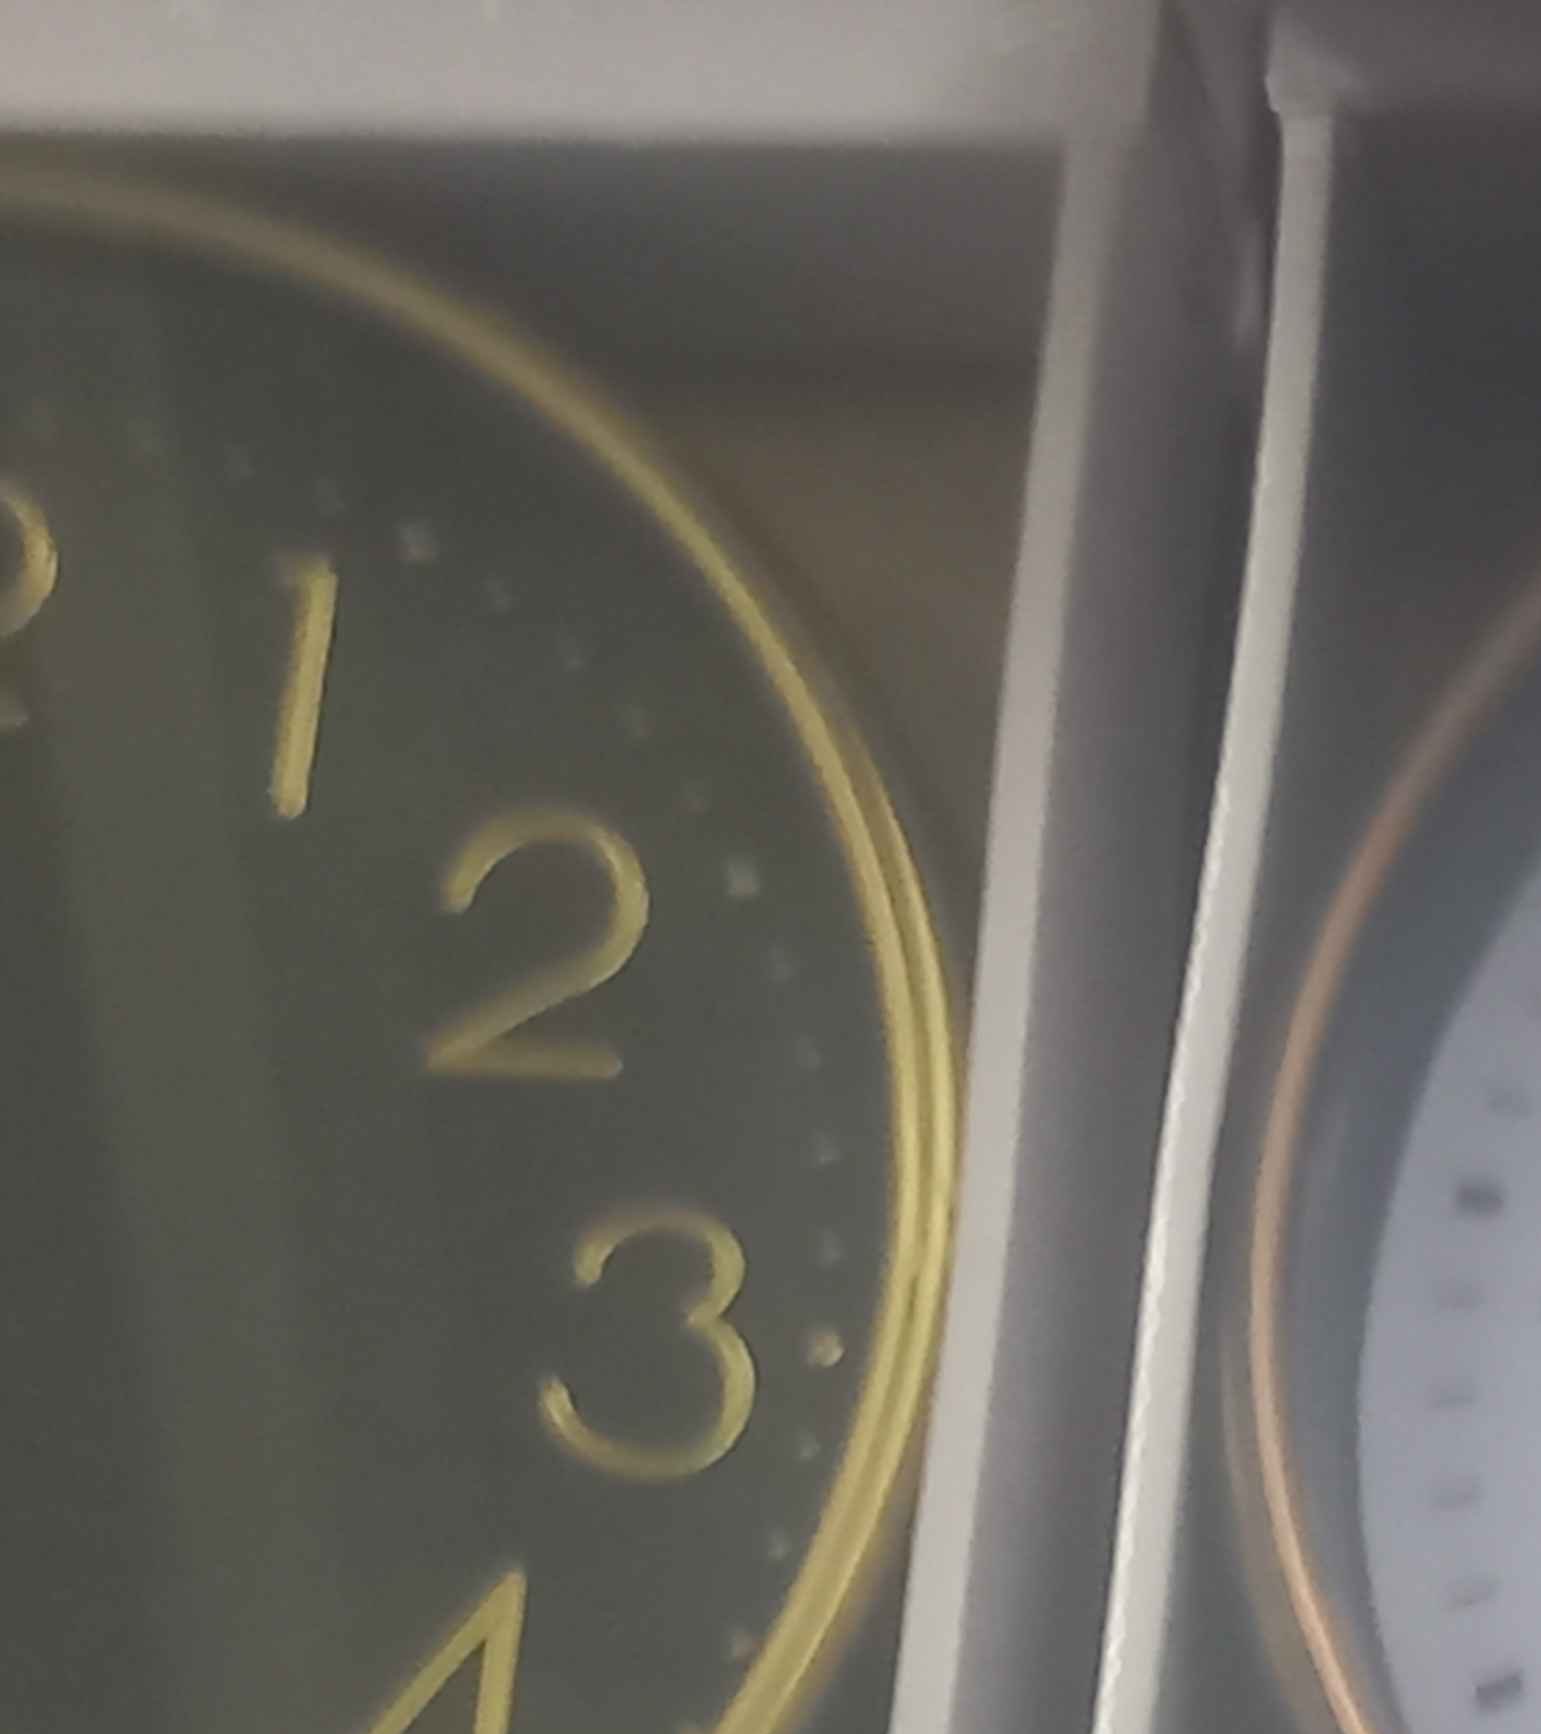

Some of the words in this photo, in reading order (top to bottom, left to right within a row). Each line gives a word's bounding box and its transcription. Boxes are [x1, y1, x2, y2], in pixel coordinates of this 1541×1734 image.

[268, 548, 340, 820] 1
[422, 806, 650, 1080] 2
[538, 1206, 758, 1482] 3
